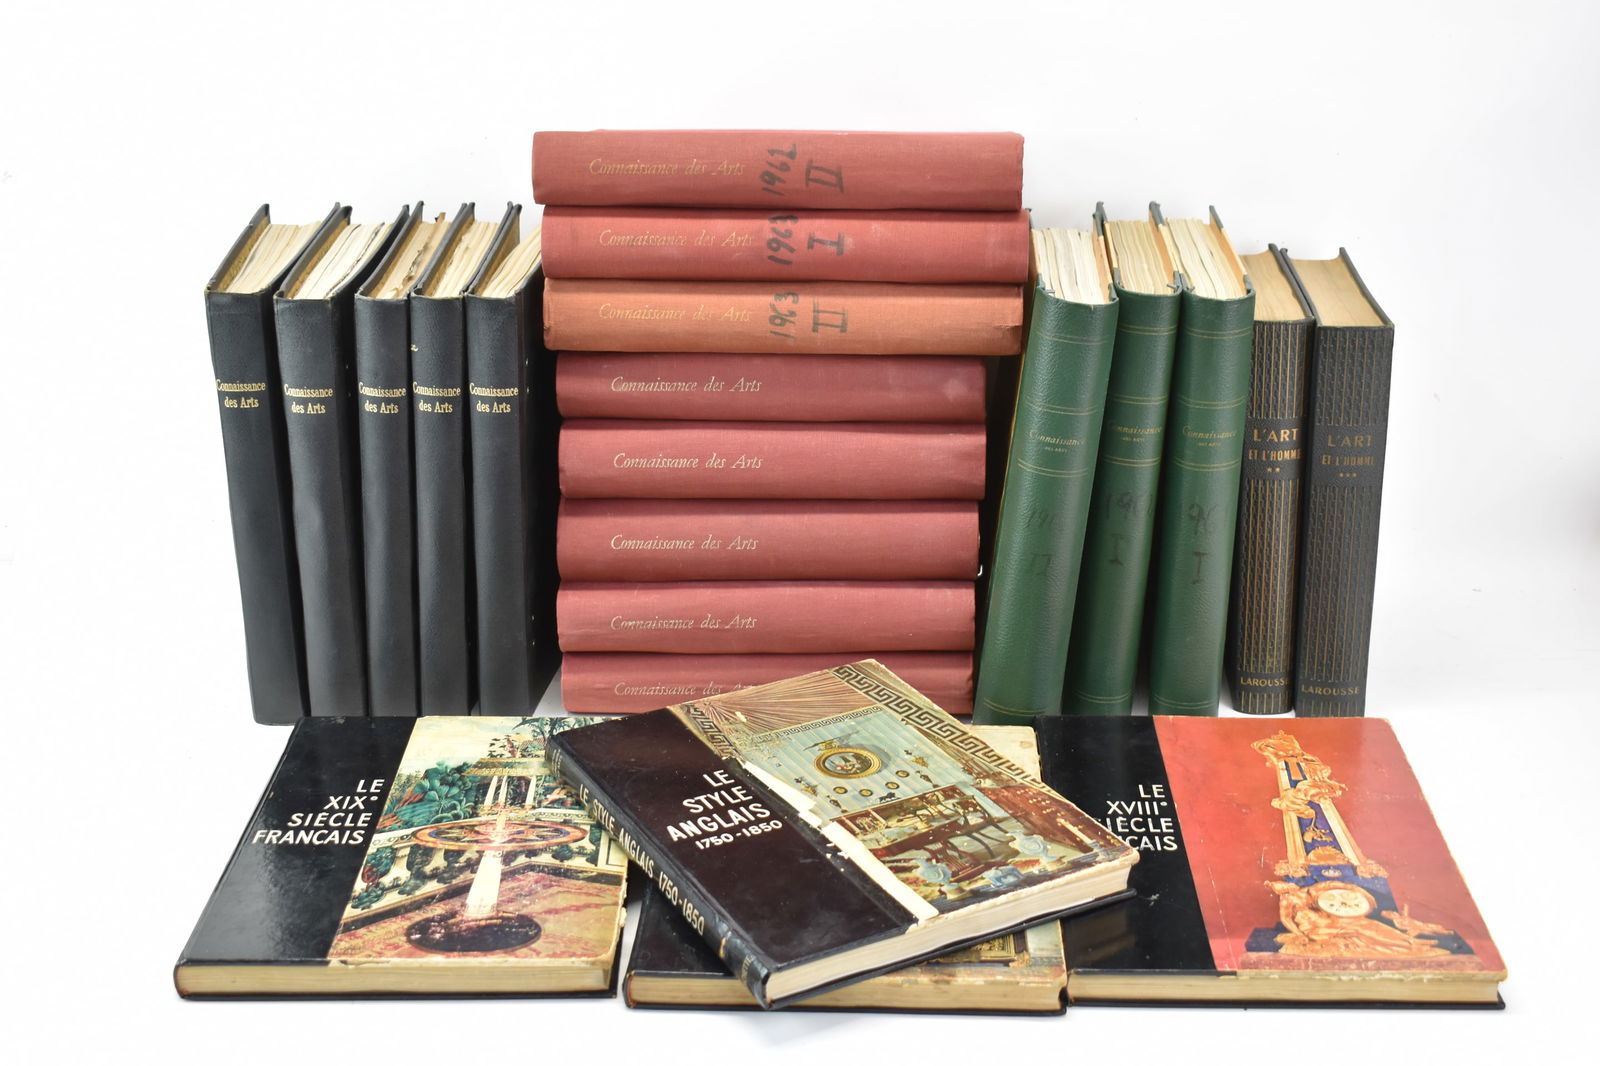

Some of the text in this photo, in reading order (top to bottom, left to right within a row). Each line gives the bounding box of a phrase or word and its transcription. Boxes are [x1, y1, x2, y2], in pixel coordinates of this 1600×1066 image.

[589, 158, 746, 176] Connaissance des Arts
[600, 229, 752, 247] Connaissance des Arts
[767, 214, 799, 265] 1963
[600, 303, 752, 322] Connaissance des Arts
[769, 291, 800, 339] 1963
[216, 378, 266, 392] Connaissance
[284, 384, 333, 398] Connaissance
[359, 382, 406, 397] Connaissance
[412, 381, 461, 397] Connaissance
[469, 382, 519, 397] Connaissance
[611, 376, 762, 392] Connaissance des Arts
[224, 397, 259, 409] des Arts
[291, 402, 326, 414] des Arts
[364, 400, 399, 414] des Arts
[418, 400, 453, 414] des Arts
[476, 400, 512, 414] des Arts
[1253, 428, 1299, 442] L'ART
[614, 452, 764, 468] Connaissance des Arts
[1248, 448, 1259, 460] ET
[1322, 454, 1332, 464] ET
[611, 534, 758, 550] Connaissance des Arts
[611, 614, 758, 630] Connaissance des Arts
[614, 682, 696, 696] Connaissance
[702, 682, 721, 695] des
[1302, 684, 1360, 696] LAROUSSE
[356, 779, 385, 793] LE
[702, 769, 735, 788] LE
[1138, 784, 1166, 798] LE
[682, 786, 753, 814] STYLE
[287, 812, 372, 827] SIÈCLE
[666, 802, 771, 842] ANGLAIS
[1096, 816, 1174, 833] IÈCLE
[252, 829, 366, 845] FRANCAIS
[580, 784, 589, 806] LE
[593, 798, 616, 836] STYLE
[618, 828, 654, 878] ANGLAIS
